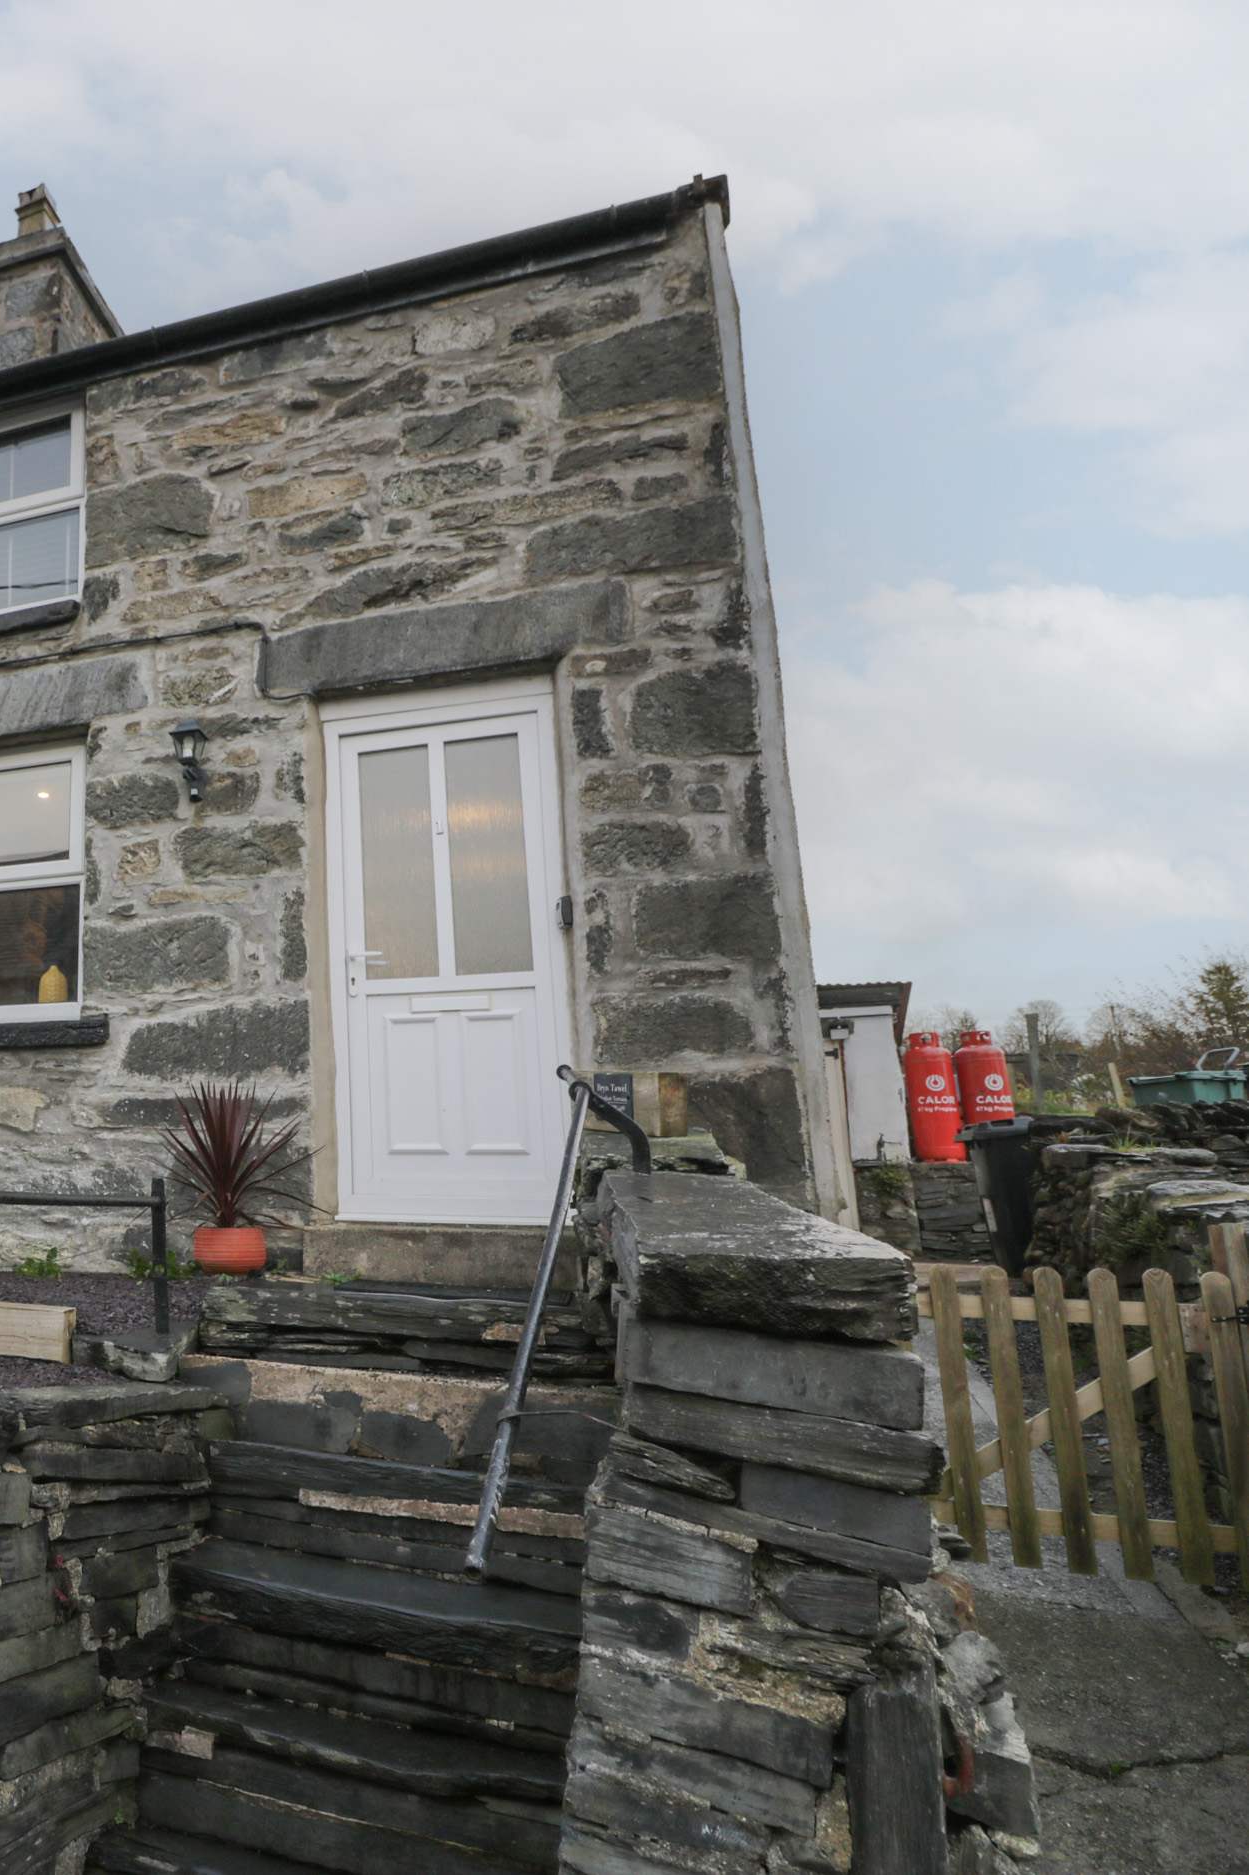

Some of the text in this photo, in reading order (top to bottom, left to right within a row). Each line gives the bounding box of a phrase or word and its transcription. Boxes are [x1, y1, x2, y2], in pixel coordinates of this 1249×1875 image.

[436, 819, 444, 835] 1
[610, 1083, 627, 1092] Tawel
[918, 1096, 956, 1104] CALOR
[976, 1095, 1011, 1104] CALOR
